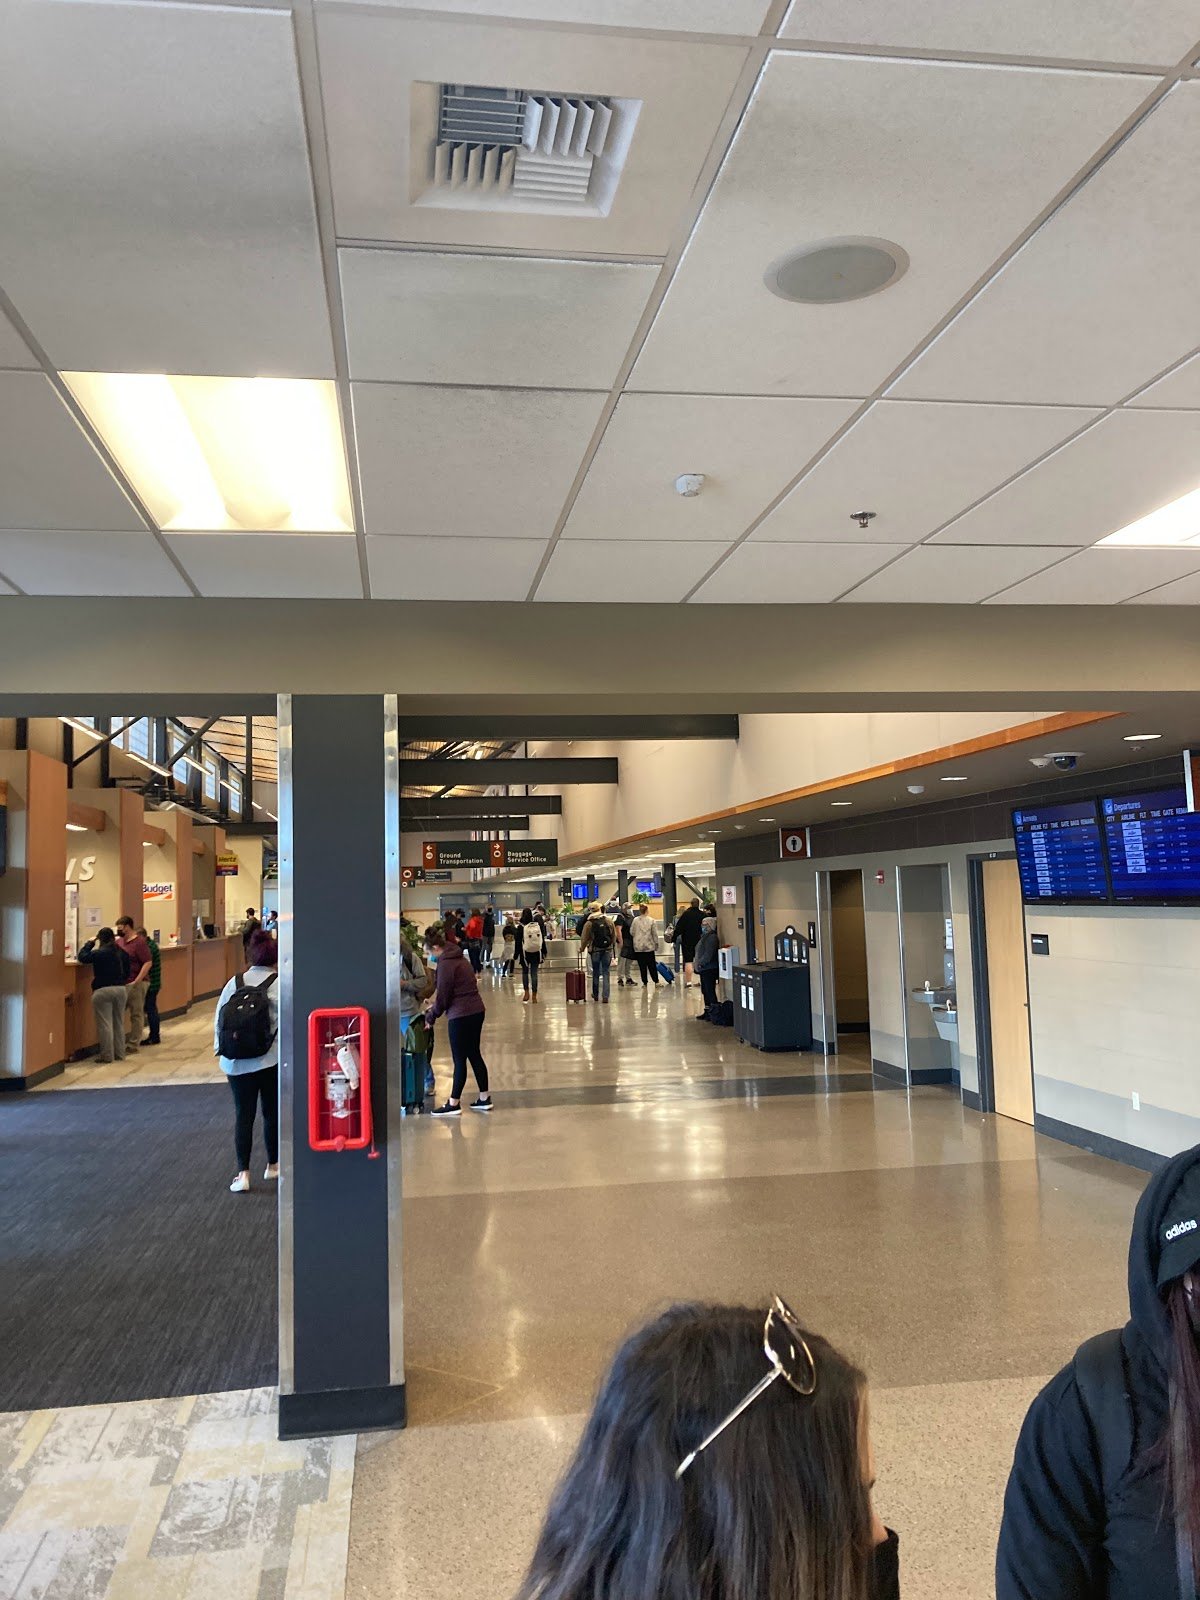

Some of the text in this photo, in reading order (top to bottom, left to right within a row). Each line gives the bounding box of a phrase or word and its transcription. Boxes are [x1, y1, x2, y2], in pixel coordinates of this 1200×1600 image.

[1114, 801, 1141, 812] Departures
[1121, 813, 1136, 821] AIRLINE
[143, 883, 172, 894] Budget
[1165, 1219, 1198, 1240] adidas
